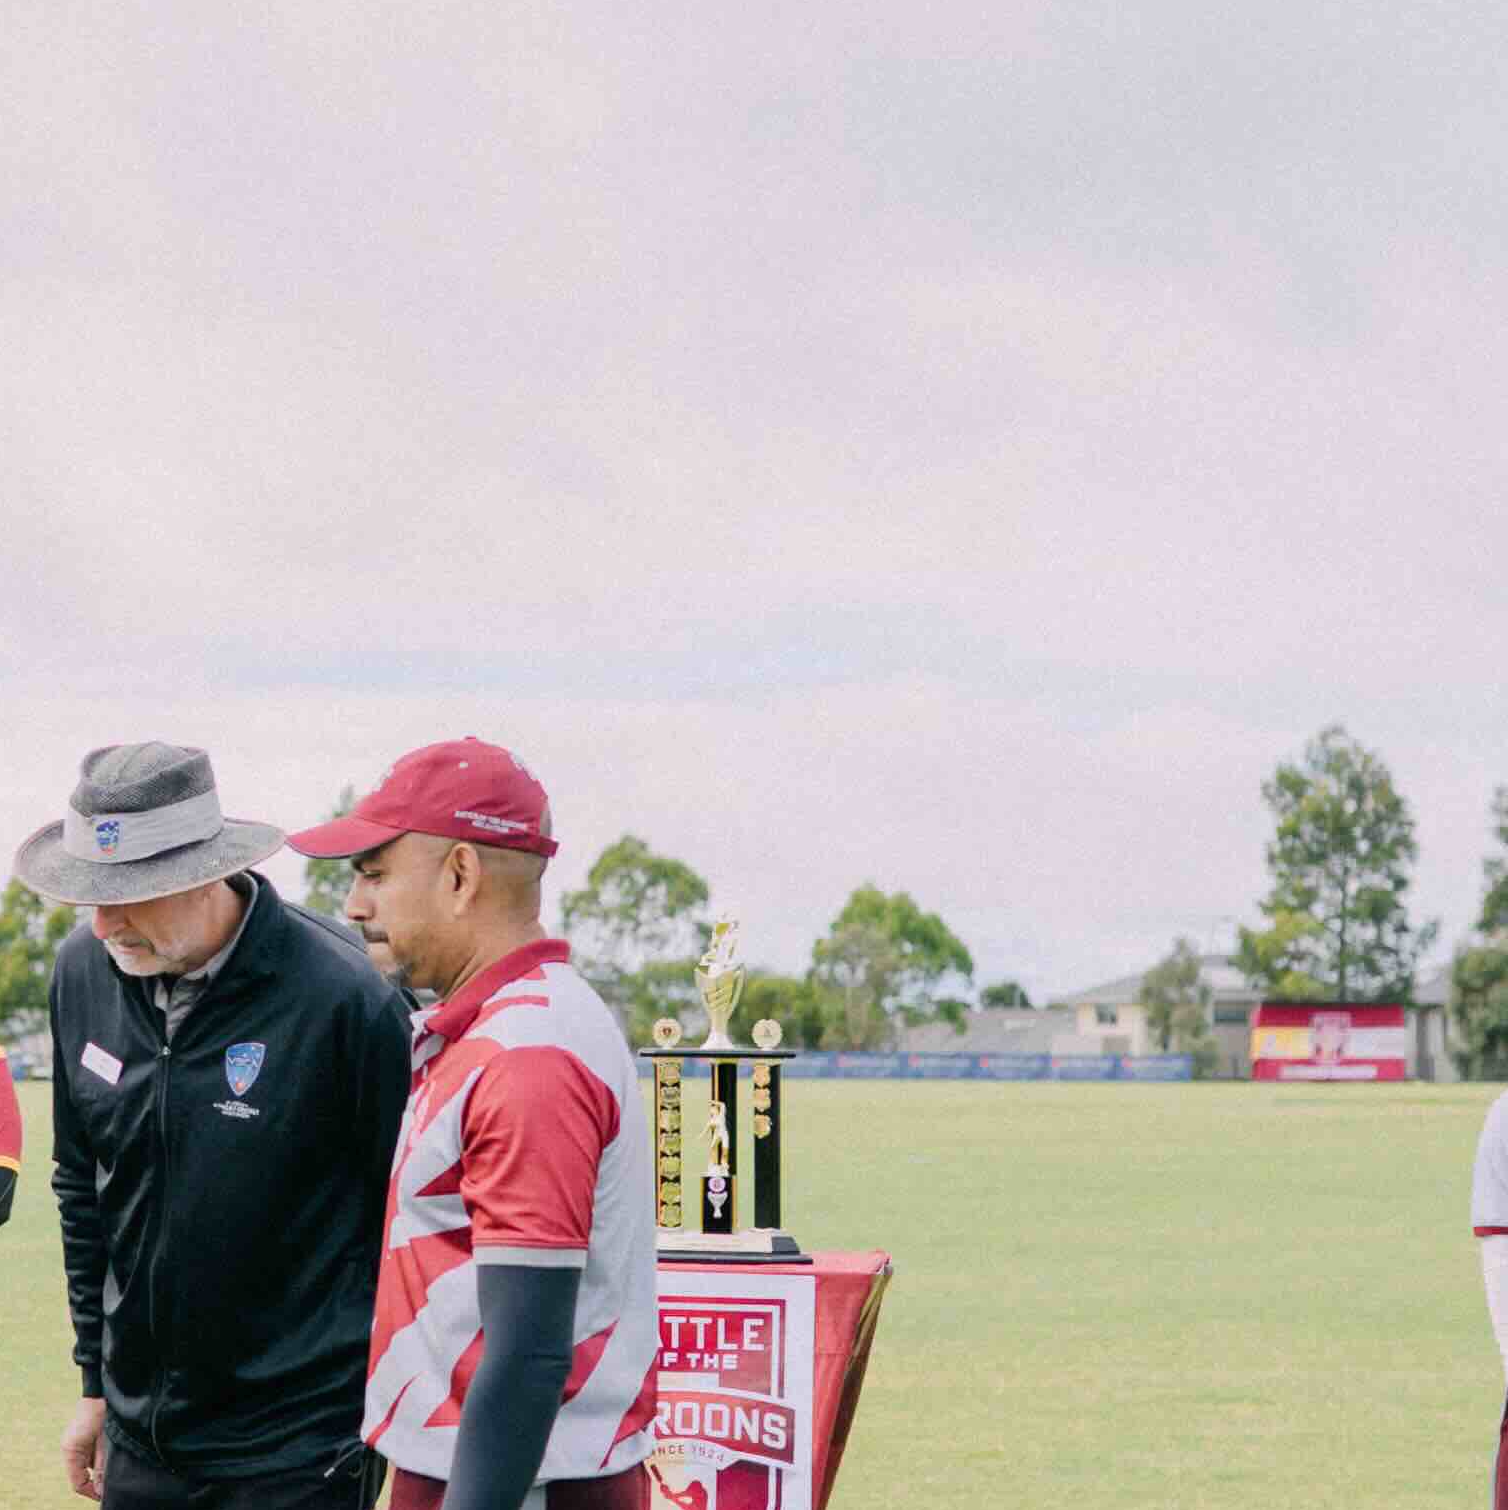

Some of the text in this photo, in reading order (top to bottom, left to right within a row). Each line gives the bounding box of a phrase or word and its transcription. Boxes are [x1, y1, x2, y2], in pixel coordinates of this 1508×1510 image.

[661, 1316, 765, 1351] TTLE
[663, 1352, 738, 1370] F THE
[655, 1401, 787, 1451] ROONS
